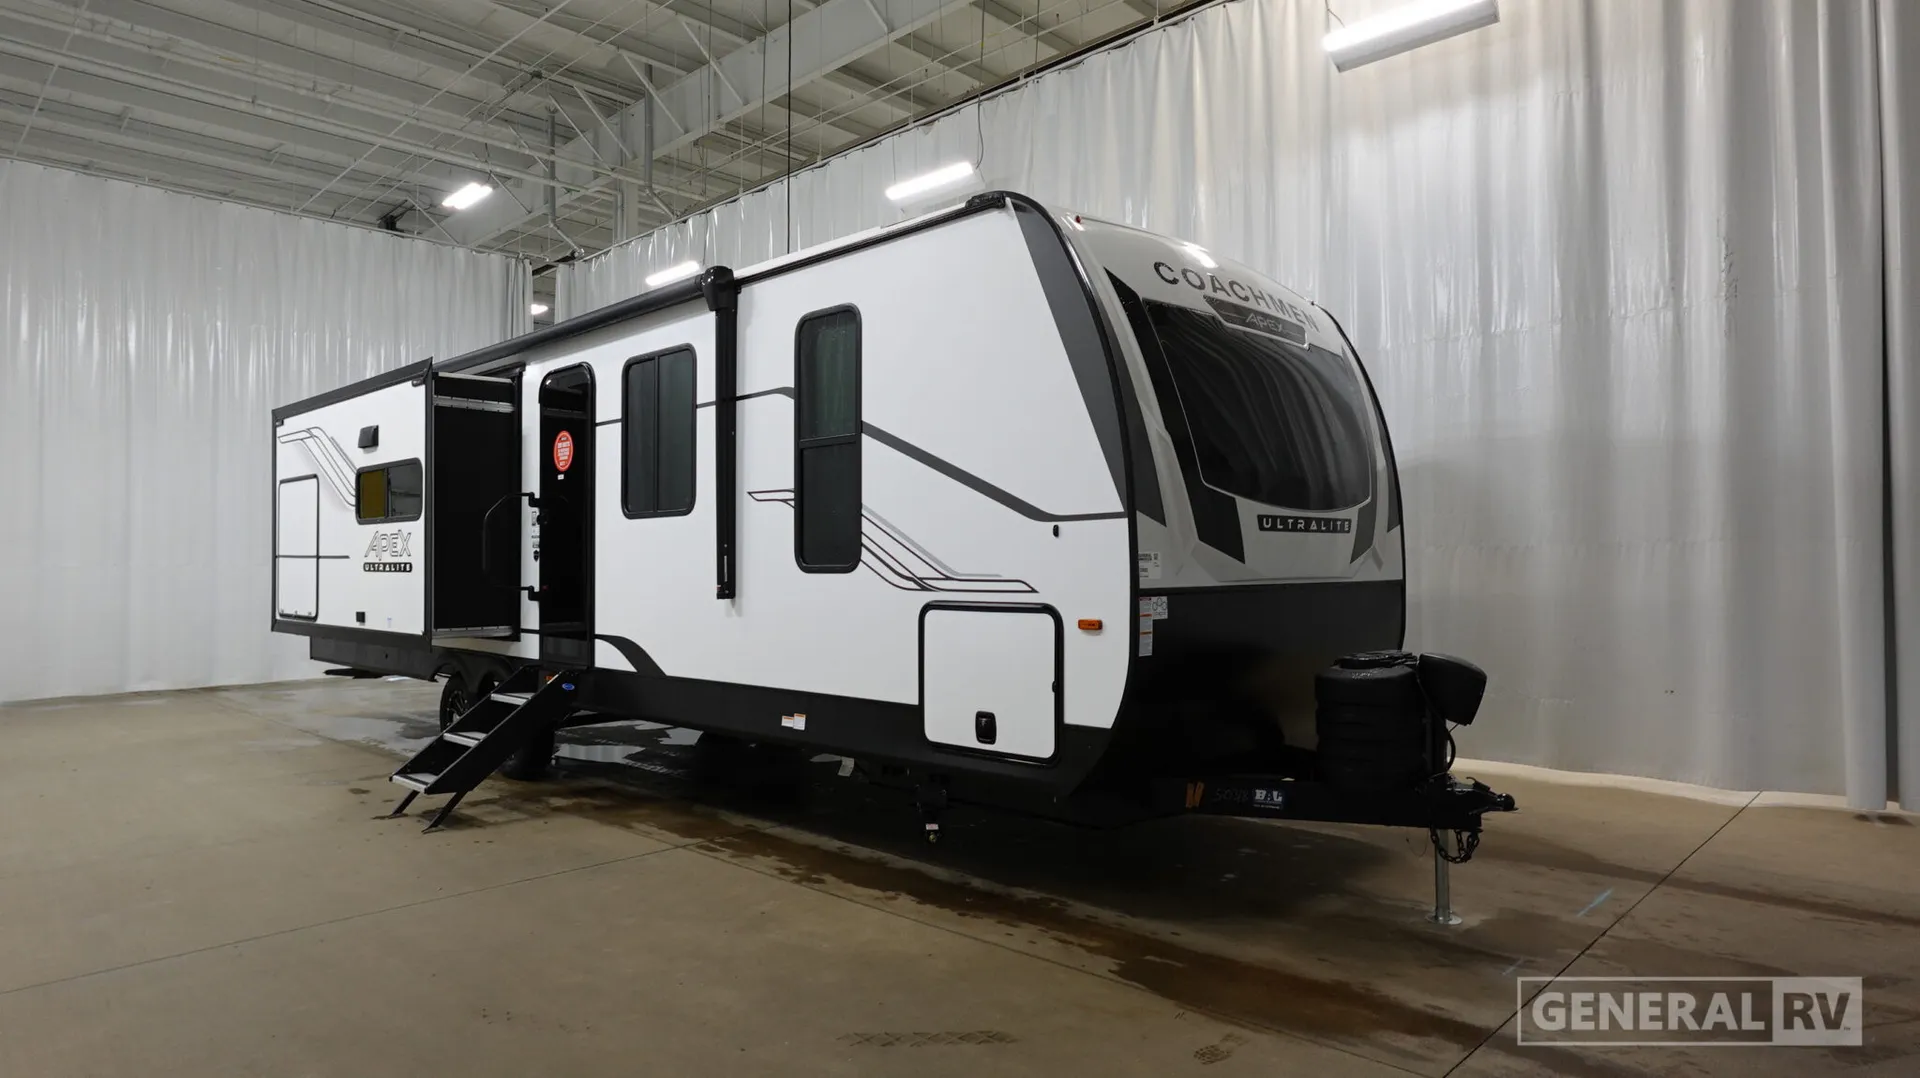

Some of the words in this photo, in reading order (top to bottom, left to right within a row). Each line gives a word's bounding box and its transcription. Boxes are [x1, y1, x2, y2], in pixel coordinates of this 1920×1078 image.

[1153, 261, 1321, 334] COACHMEN
[1246, 312, 1284, 333] APEX
[1262, 517, 1350, 532] ULTRALITE
[364, 529, 412, 561] APEX
[364, 563, 412, 572] ULTRALITE
